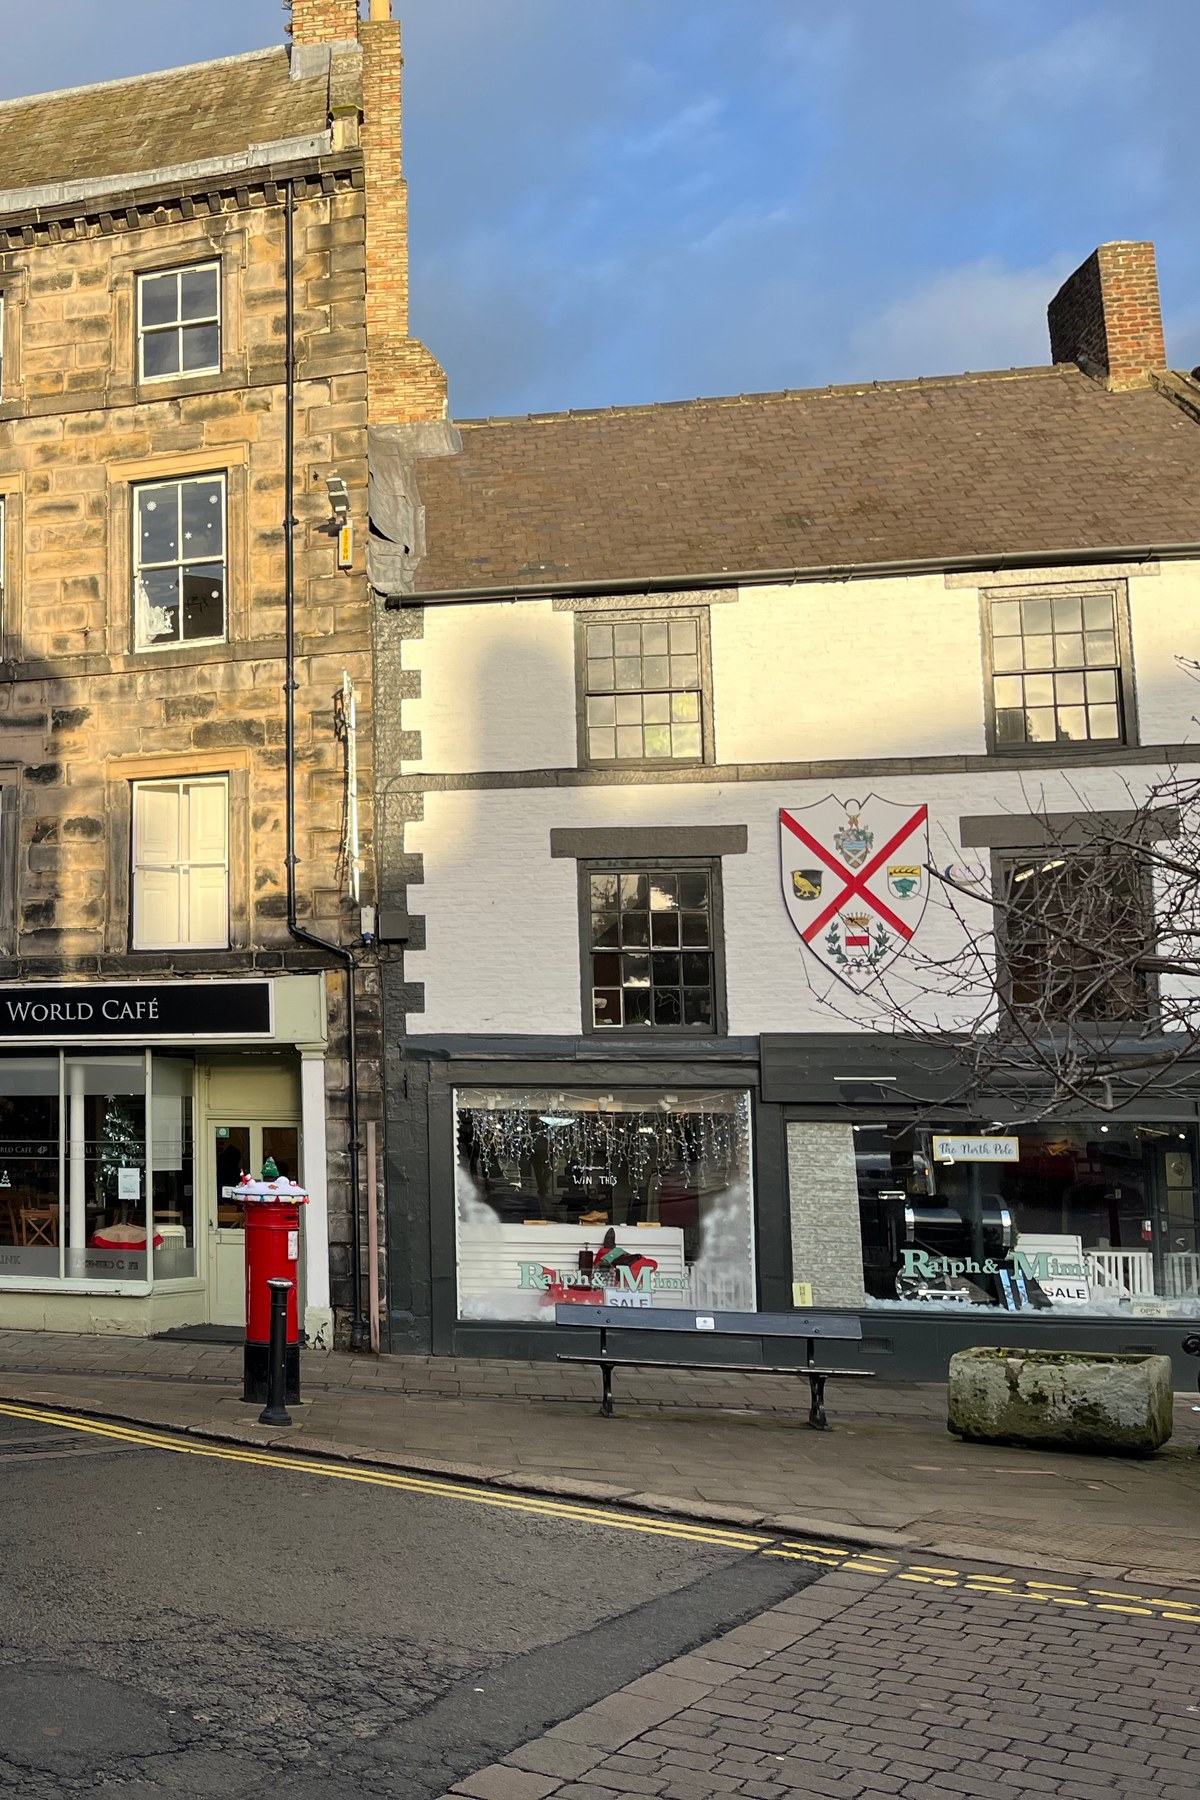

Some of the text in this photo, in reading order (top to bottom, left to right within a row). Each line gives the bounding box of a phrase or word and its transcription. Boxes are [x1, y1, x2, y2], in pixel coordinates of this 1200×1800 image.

[6, 1001, 93, 1021] WORLD
[102, 998, 159, 1020] CAFÉ
[939, 1143, 1013, 1154] The North Pole
[1010, 1252, 1092, 1281] Mimi
[616, 1265, 691, 1293] Mimi
[1044, 1287, 1087, 1300] SALE
[609, 1299, 648, 1308] SALE
